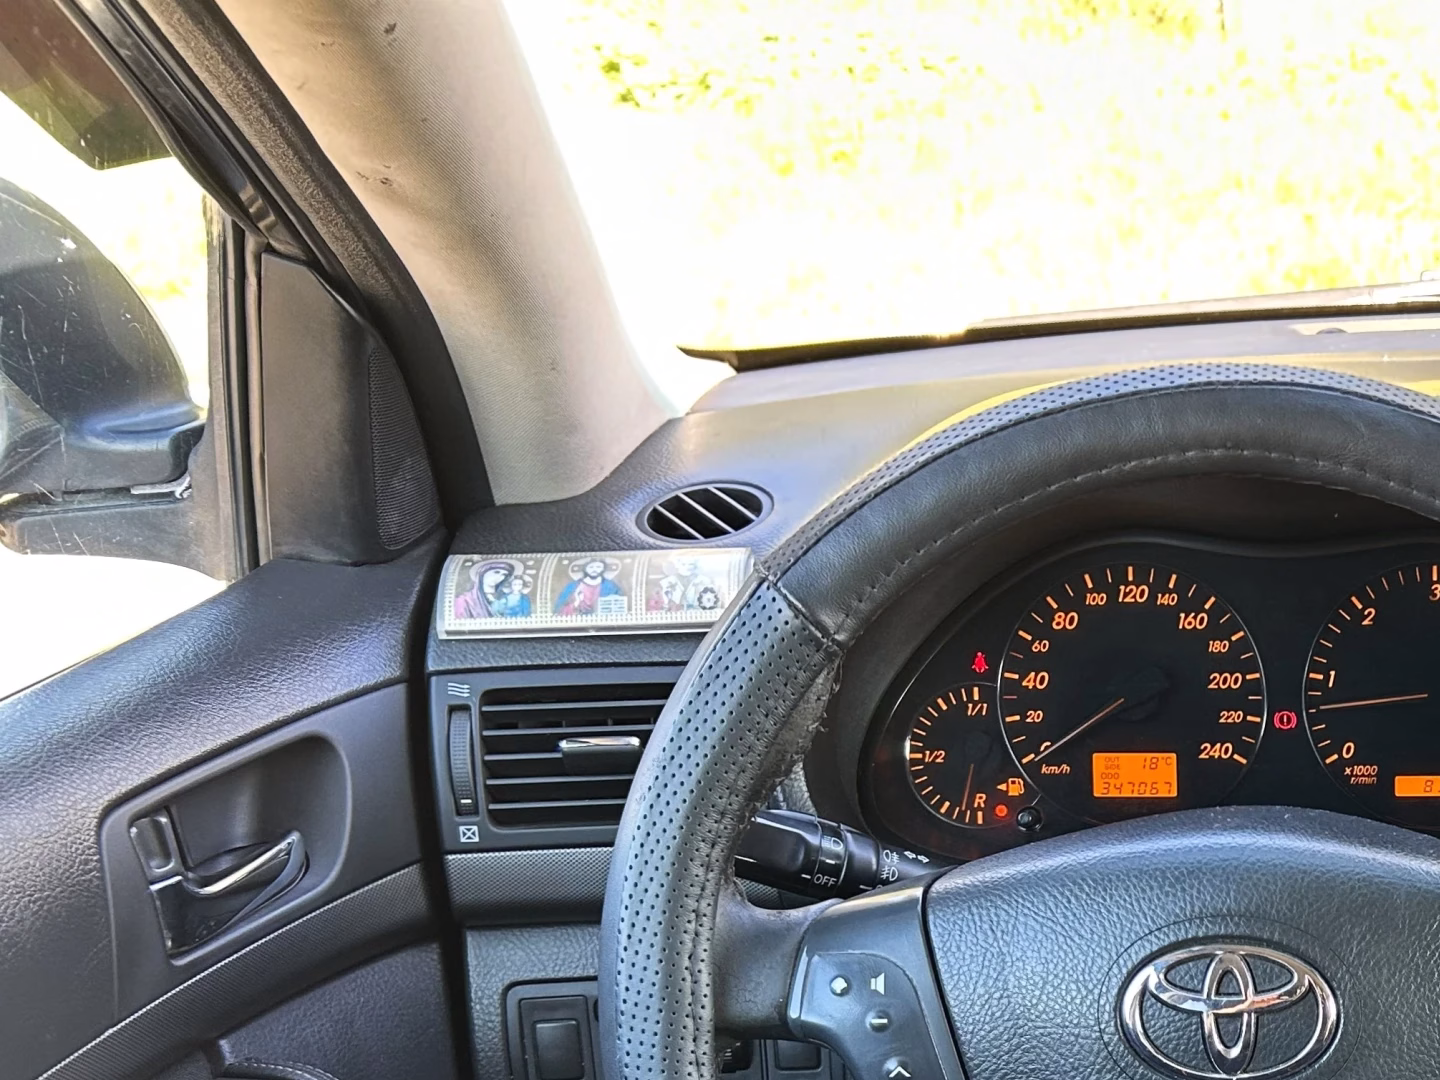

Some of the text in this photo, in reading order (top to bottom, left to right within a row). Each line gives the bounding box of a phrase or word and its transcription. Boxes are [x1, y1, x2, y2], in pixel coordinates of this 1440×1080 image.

[1085, 593, 1106, 605] 100
[1118, 585, 1148, 603] 120
[1156, 593, 1177, 605] 140
[1052, 612, 1078, 630] 80
[1178, 612, 1208, 630] 160
[1361, 609, 1376, 626] 2
[1032, 640, 1049, 653] 60
[1208, 640, 1229, 653] 180
[1022, 672, 1049, 689] 40
[1207, 673, 1242, 689] 200
[1327, 670, 1336, 688] 1
[967, 703, 987, 716] 1/1
[1025, 711, 1043, 723] 20
[1219, 711, 1243, 723] 220
[924, 750, 945, 764] 1/2
[1199, 743, 1233, 760] 240
[1342, 742, 1355, 759] 0
[1041, 764, 1071, 775] km/h
[1350, 775, 1377, 785] r/min
[1101, 782, 1172, 795] 347067
[974, 793, 987, 808] R
[814, 874, 837, 887] OFF
